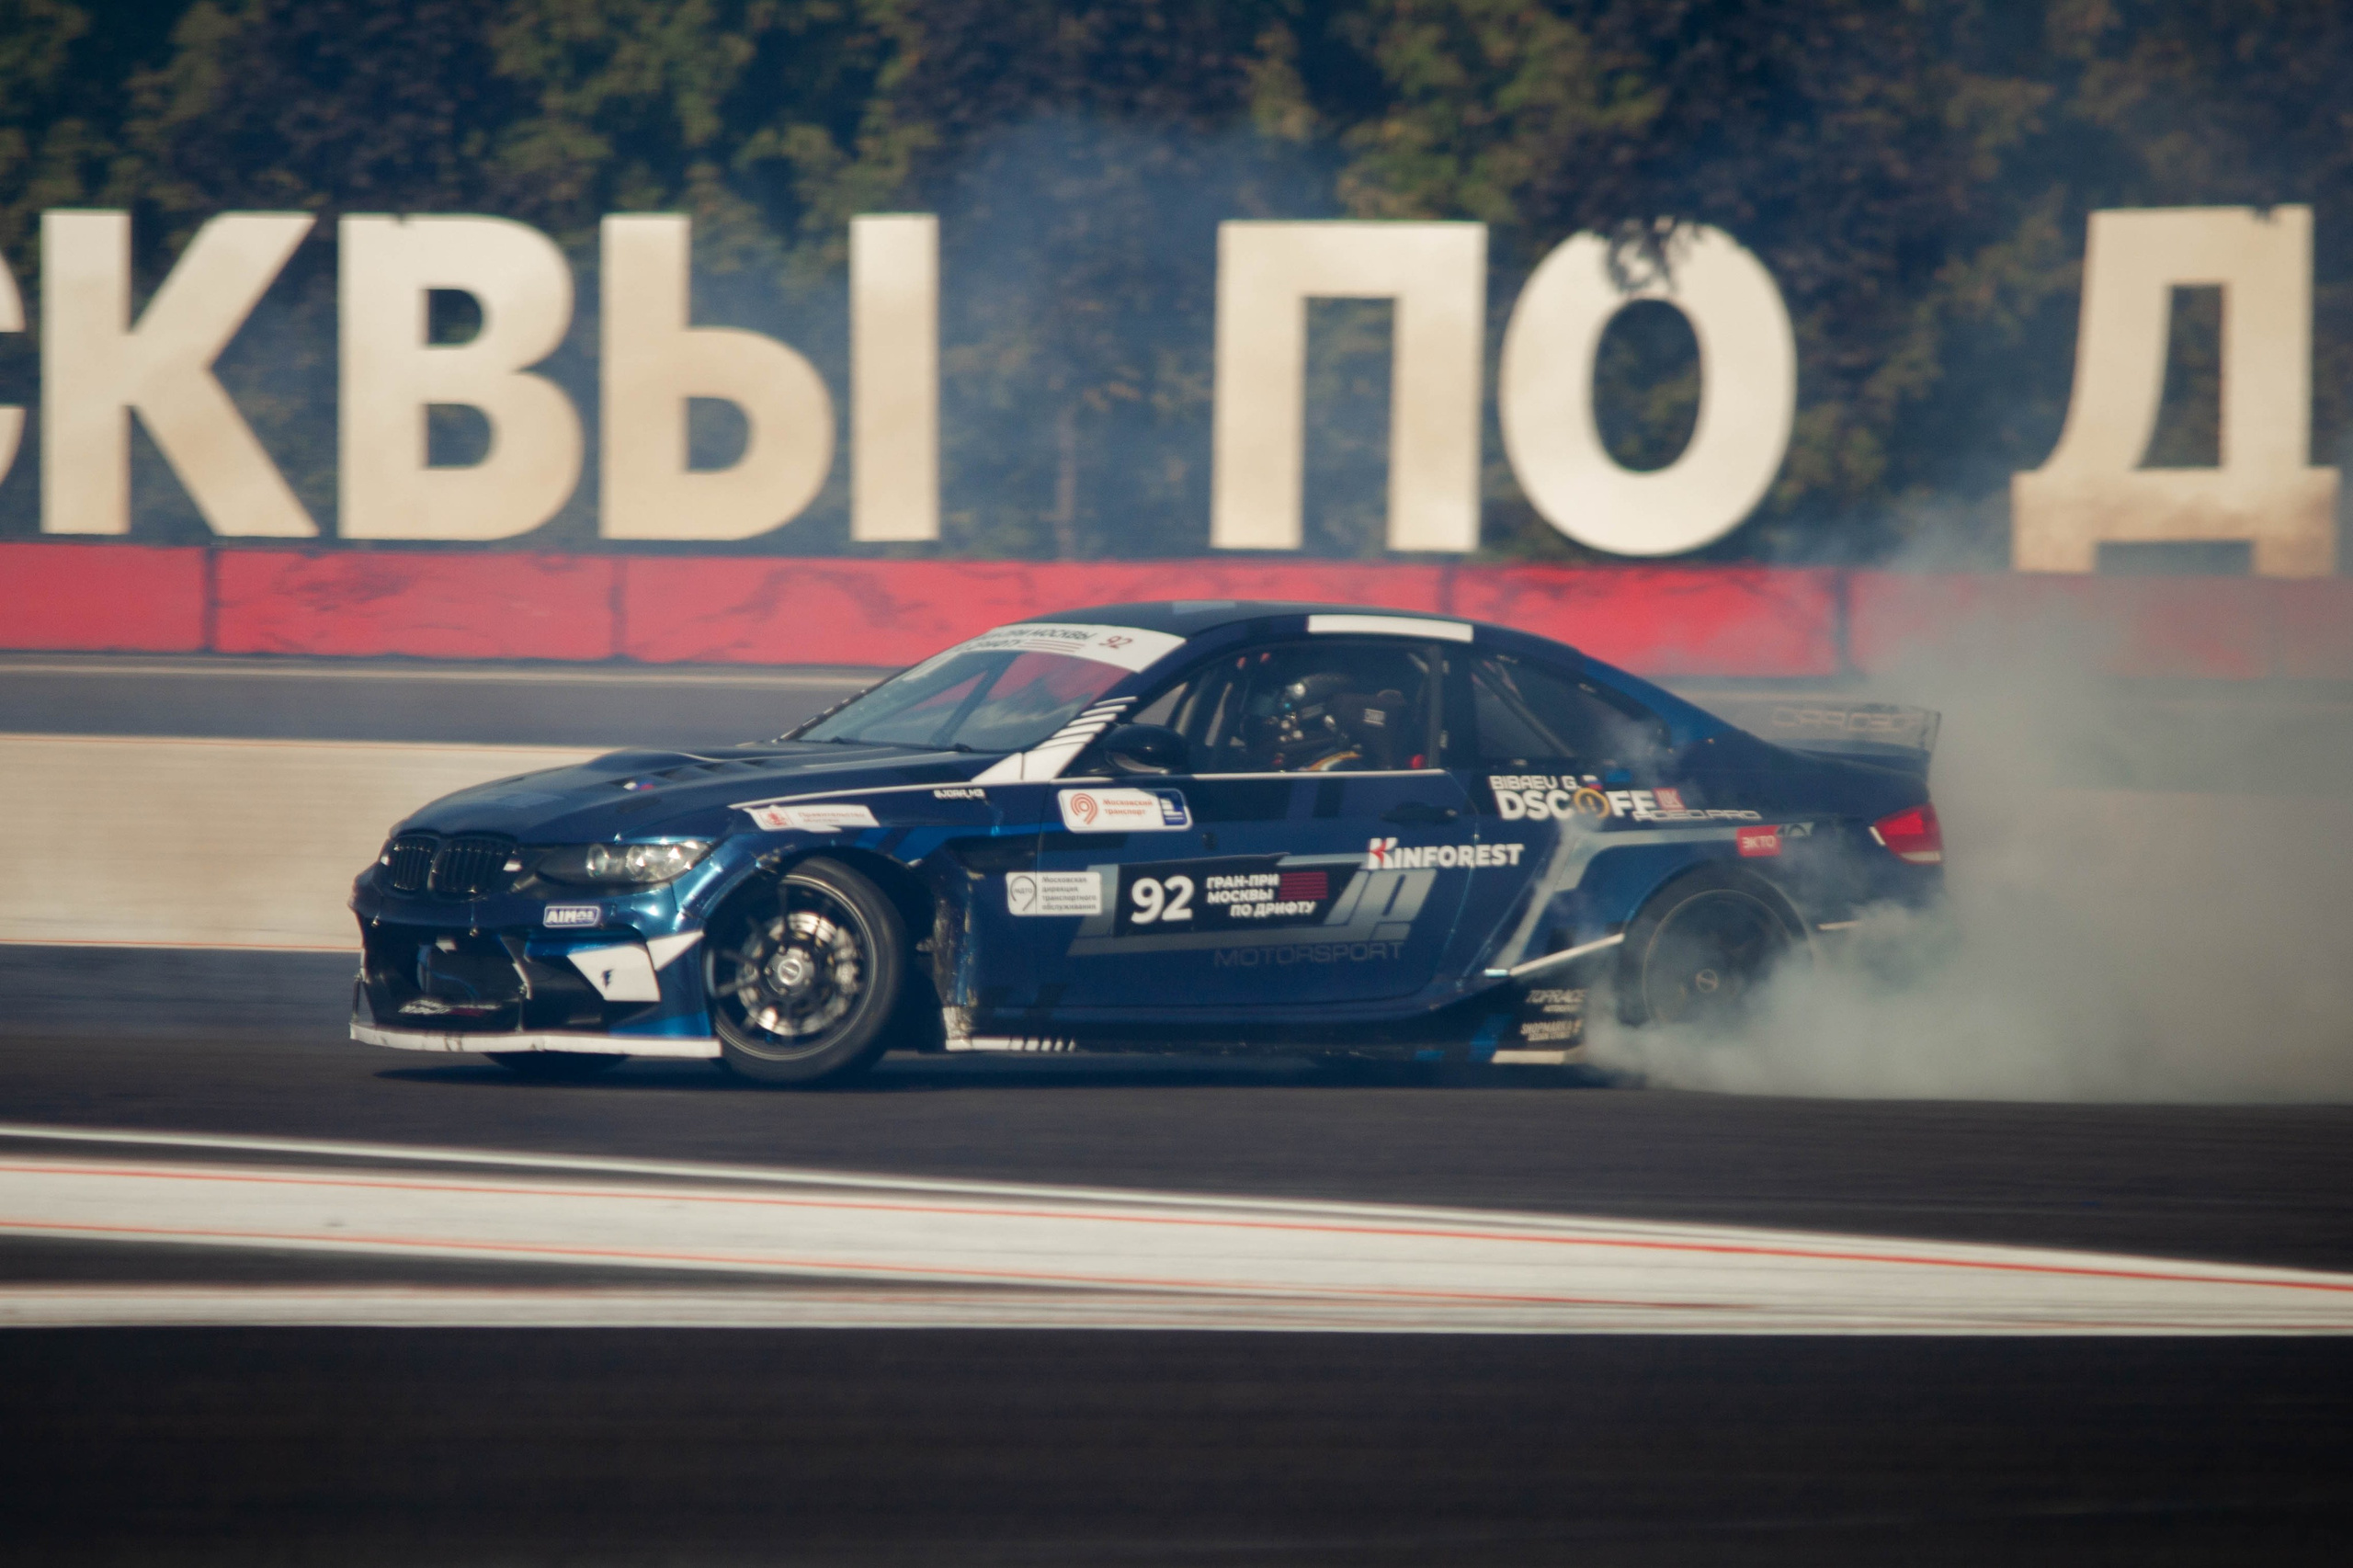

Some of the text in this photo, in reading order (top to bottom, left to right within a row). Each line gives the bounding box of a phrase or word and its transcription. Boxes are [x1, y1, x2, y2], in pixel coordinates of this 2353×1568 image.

[0, 209, 939, 542] КВЫ
[1210, 218, 1798, 557] ПО
[2011, 204, 2341, 576] Д
[1097, 634, 1134, 650] 92
[1102, 798, 1154, 808] Московский
[1104, 808, 1146, 816] транспорт
[1366, 837, 1525, 869] KINFOREST
[1206, 873, 1280, 890] ГРАН-ПРИ
[1130, 875, 1195, 926] 92
[1206, 888, 1274, 904] МОСКВЫ
[1229, 901, 1318, 918] ПО ДРИФТУ
[1213, 940, 1404, 967] MOTORSPORT
